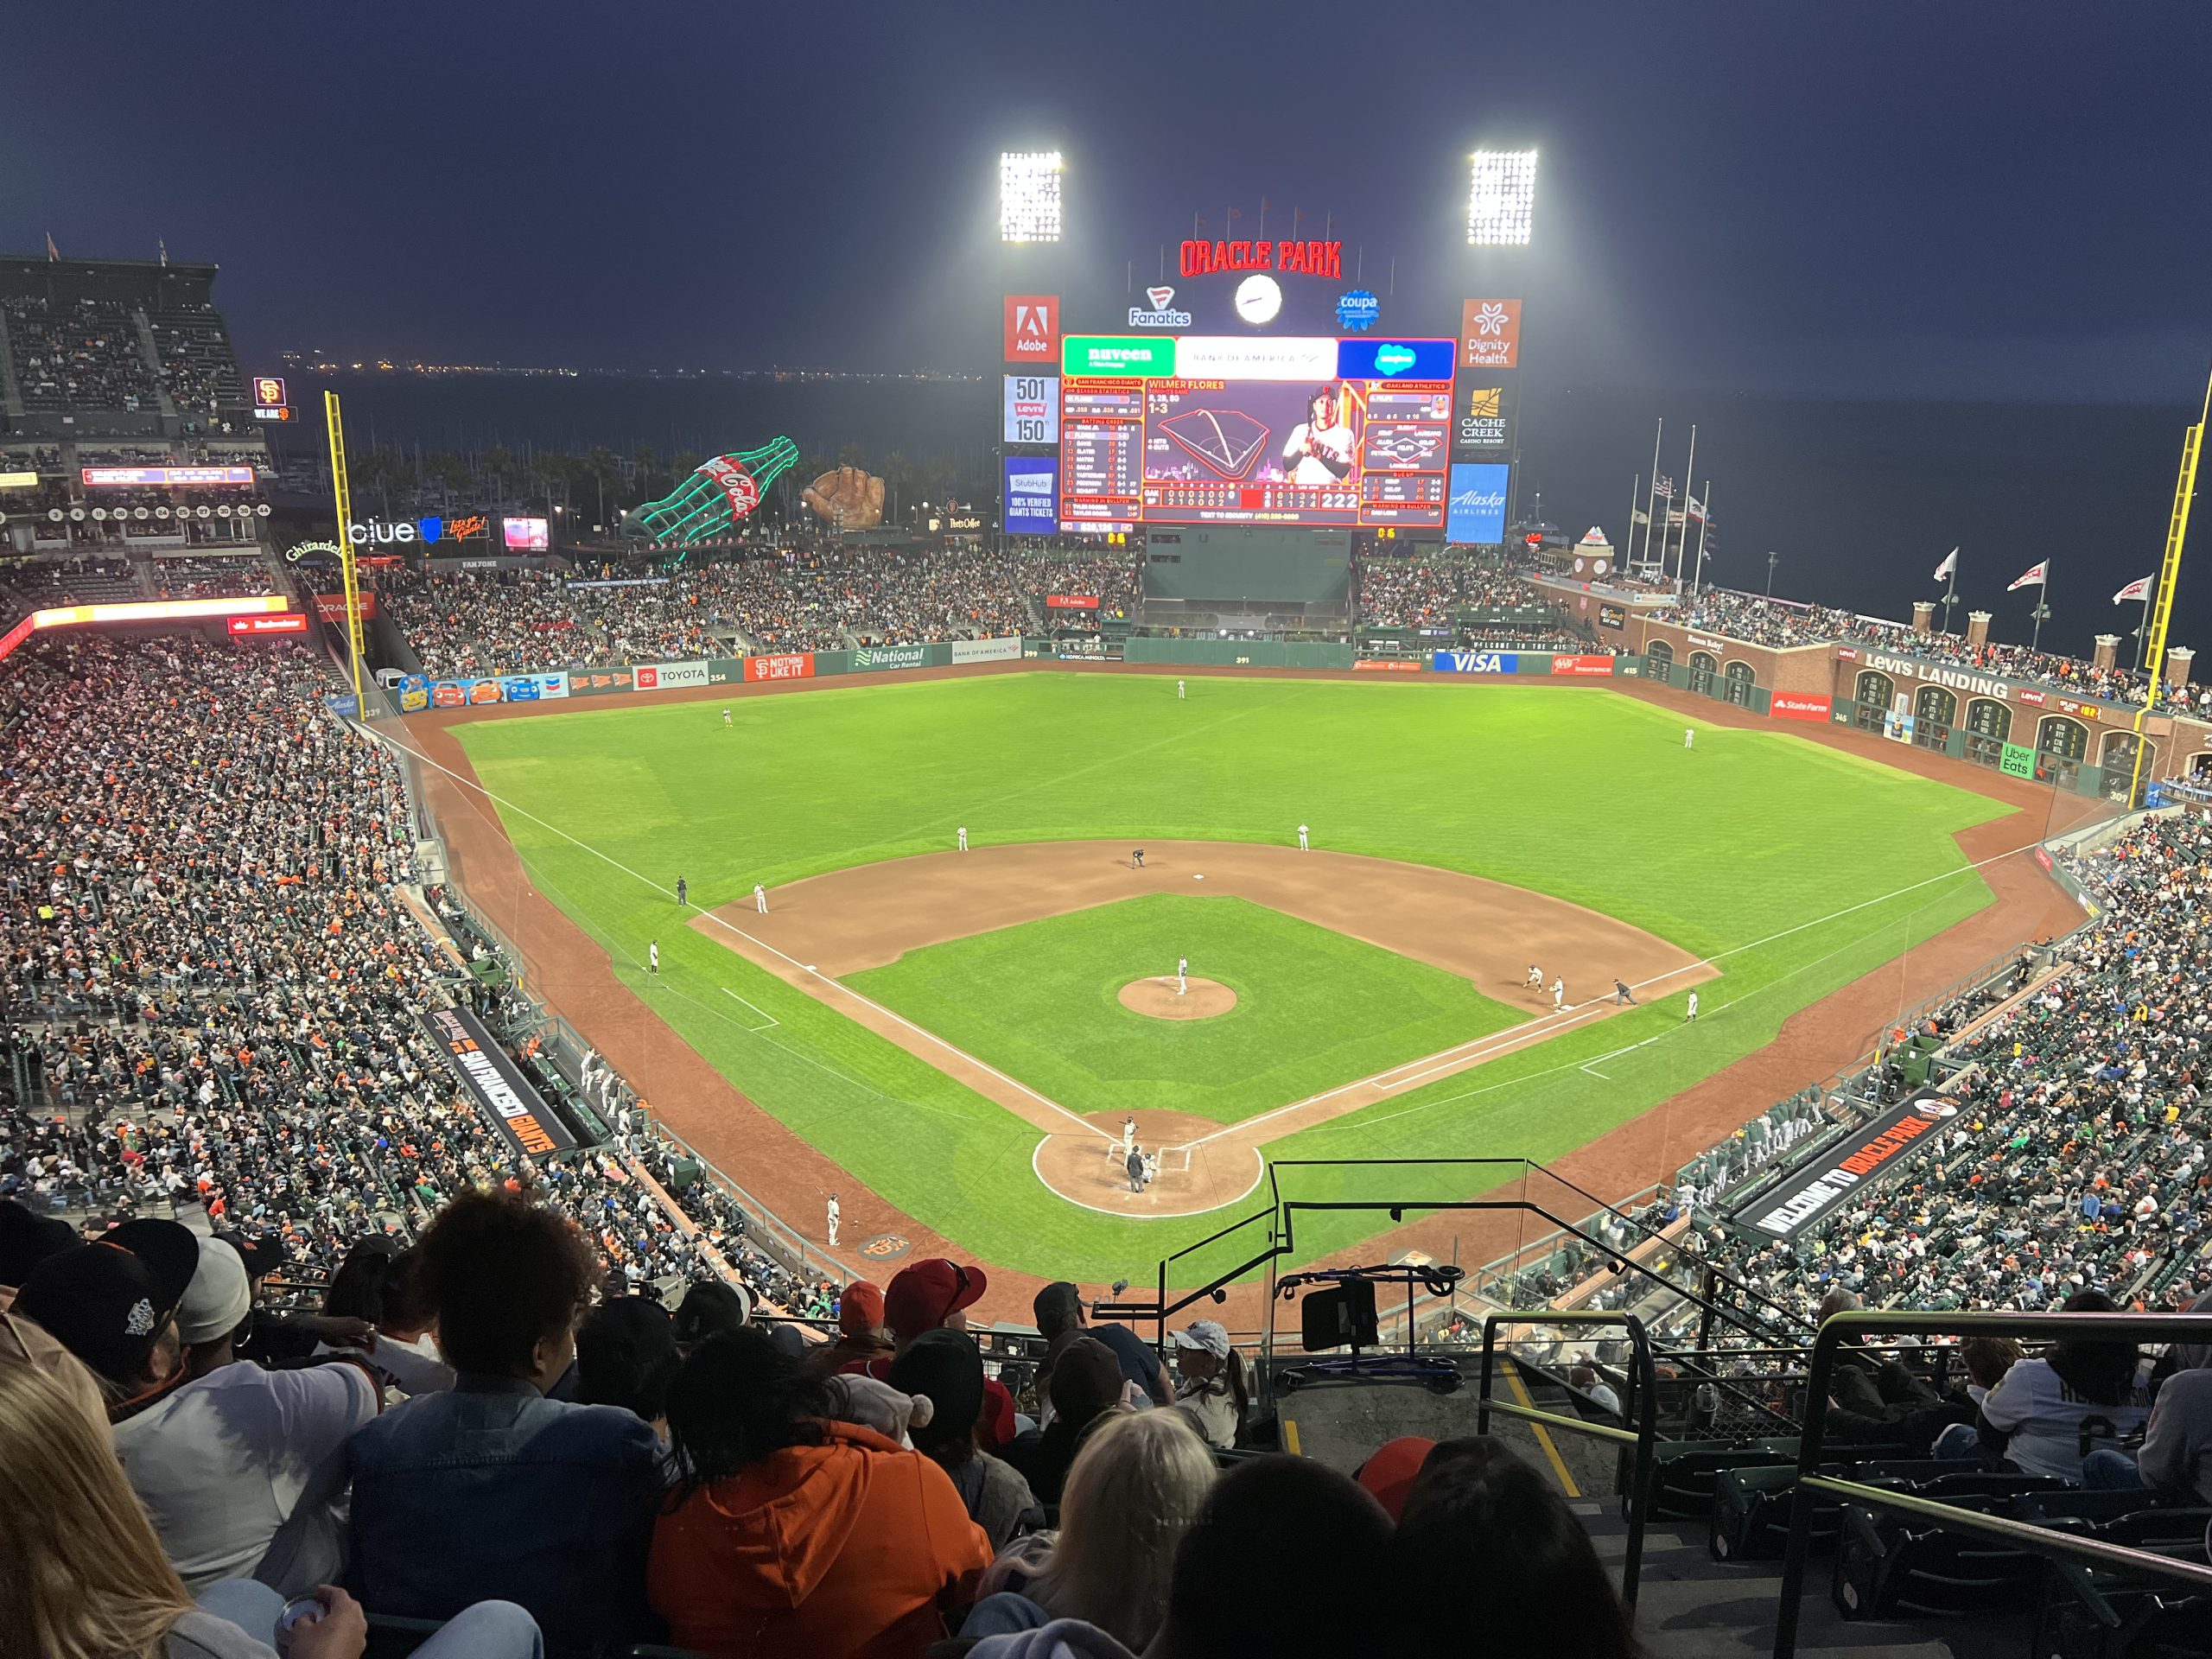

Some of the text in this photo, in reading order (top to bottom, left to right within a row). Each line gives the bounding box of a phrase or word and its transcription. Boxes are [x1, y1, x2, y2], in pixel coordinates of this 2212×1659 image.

[1180, 240, 1341, 279] ORACLE PARK
[1341, 298, 1377, 310] coupa
[1130, 308, 1189, 324] Fanatics
[1017, 340, 1047, 352] Adobe
[1469, 340, 1510, 353] Dignity
[1088, 348, 1152, 361] nuveen
[1469, 353, 1507, 364] Health
[1017, 378, 1045, 400] 501
[1149, 380, 1224, 389] WILMER FLORES
[254, 409, 265, 419] WE
[266, 409, 280, 419] ARE
[1149, 404, 1167, 413] 1-3
[1462, 418, 1506, 427] CACHE
[1462, 428, 1503, 437] CREEK
[1015, 479, 1047, 488] StubHub
[1189, 491, 1194, 499] 0
[1198, 491, 1204, 499] 3
[1218, 491, 1224, 499] 0
[1228, 490, 1235, 499] 0
[1451, 489, 1505, 506] Alaska
[1011, 498, 1051, 507] 100% VERIFIED
[1265, 500, 1271, 508] 5
[1277, 500, 1283, 508] 5
[1009, 508, 1053, 517] GIANTS TICKETS
[964, 518, 981, 528] Coffee
[286, 539, 343, 562] Ghirardel
[1474, 642, 1510, 650] WELCOME
[1688, 635, 1723, 651] Humm Baby!
[872, 648, 924, 664] National
[769, 657, 804, 669] NOTHING
[1450, 654, 1501, 672] VISA
[661, 670, 705, 681] TOYOTA
[770, 664, 804, 678] LIKE IT
[710, 674, 726, 682] 354
[1918, 665, 2009, 699] LANDING
[330, 701, 355, 710] Alaska
[1786, 701, 1827, 712] State Farm
[2059, 700, 2079, 710] SPLASH
[365, 708, 381, 718] 339
[1835, 713, 1847, 722] 365
[2081, 705, 2096, 718] 102
[2005, 747, 2030, 762] Uber
[2003, 759, 2028, 775] Eats
[2109, 791, 2128, 803] 309
[458, 1048, 493, 1073] SAN
[469, 1066, 529, 1119] FRANCISCO
[506, 1114, 556, 1154] GIANTS
[1757, 1116, 1933, 1233] WELCOME TO ORACLE PARK
